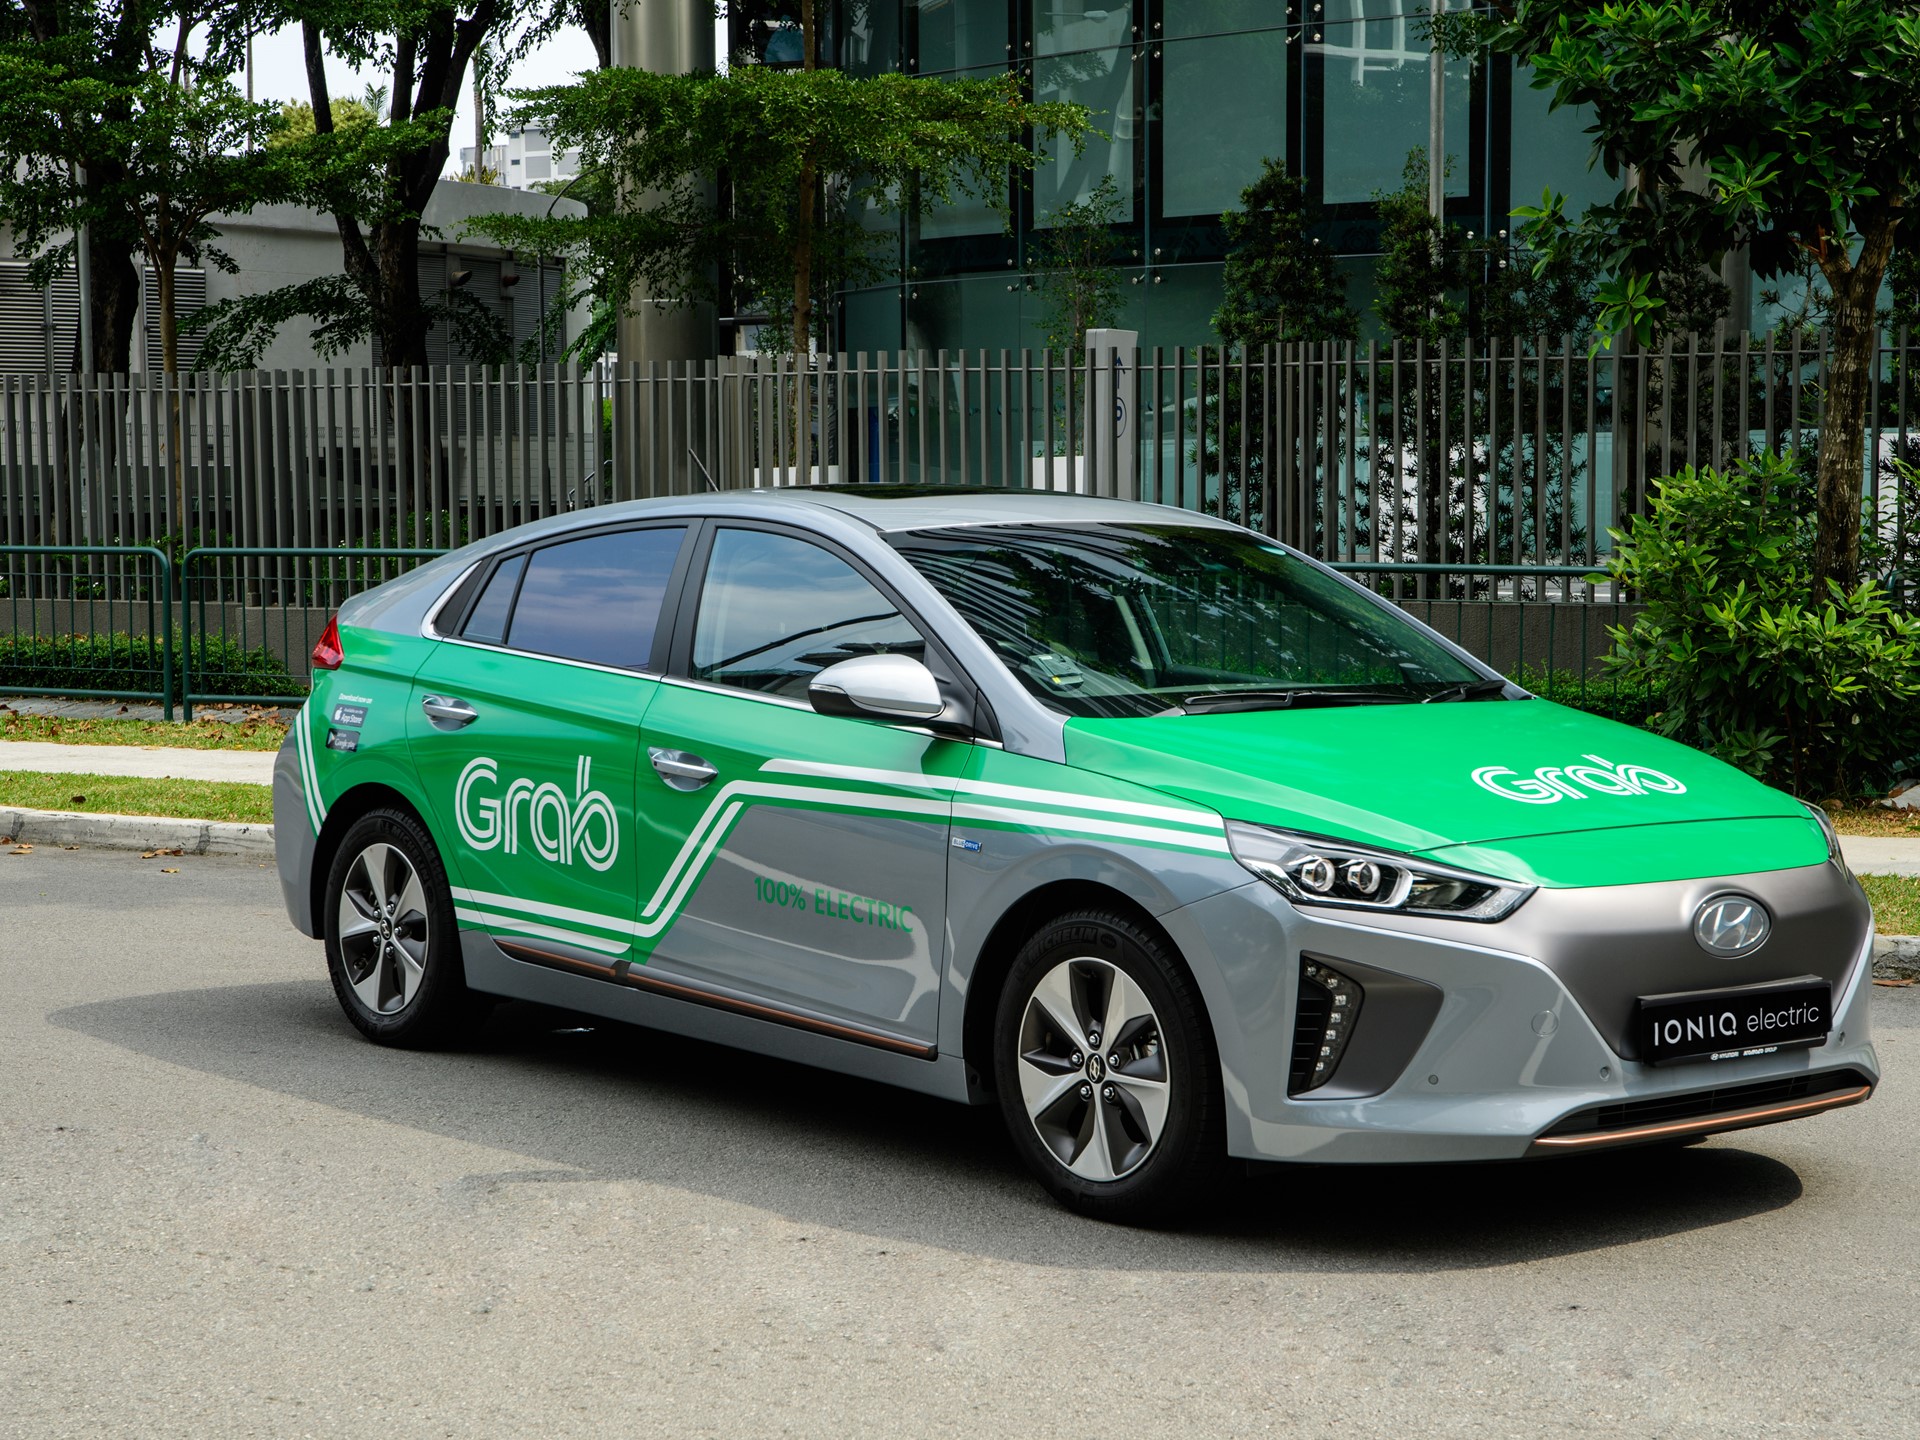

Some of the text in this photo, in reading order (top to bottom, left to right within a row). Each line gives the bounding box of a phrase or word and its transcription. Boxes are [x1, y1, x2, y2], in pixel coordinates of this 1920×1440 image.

[1471, 754, 1687, 804] Grab
[455, 755, 619, 871] Grab
[754, 876, 913, 933] 100% ELECTRIC
[1026, 927, 1098, 962] MICHELIN
[1654, 1002, 1820, 1046] IONIQ electric
